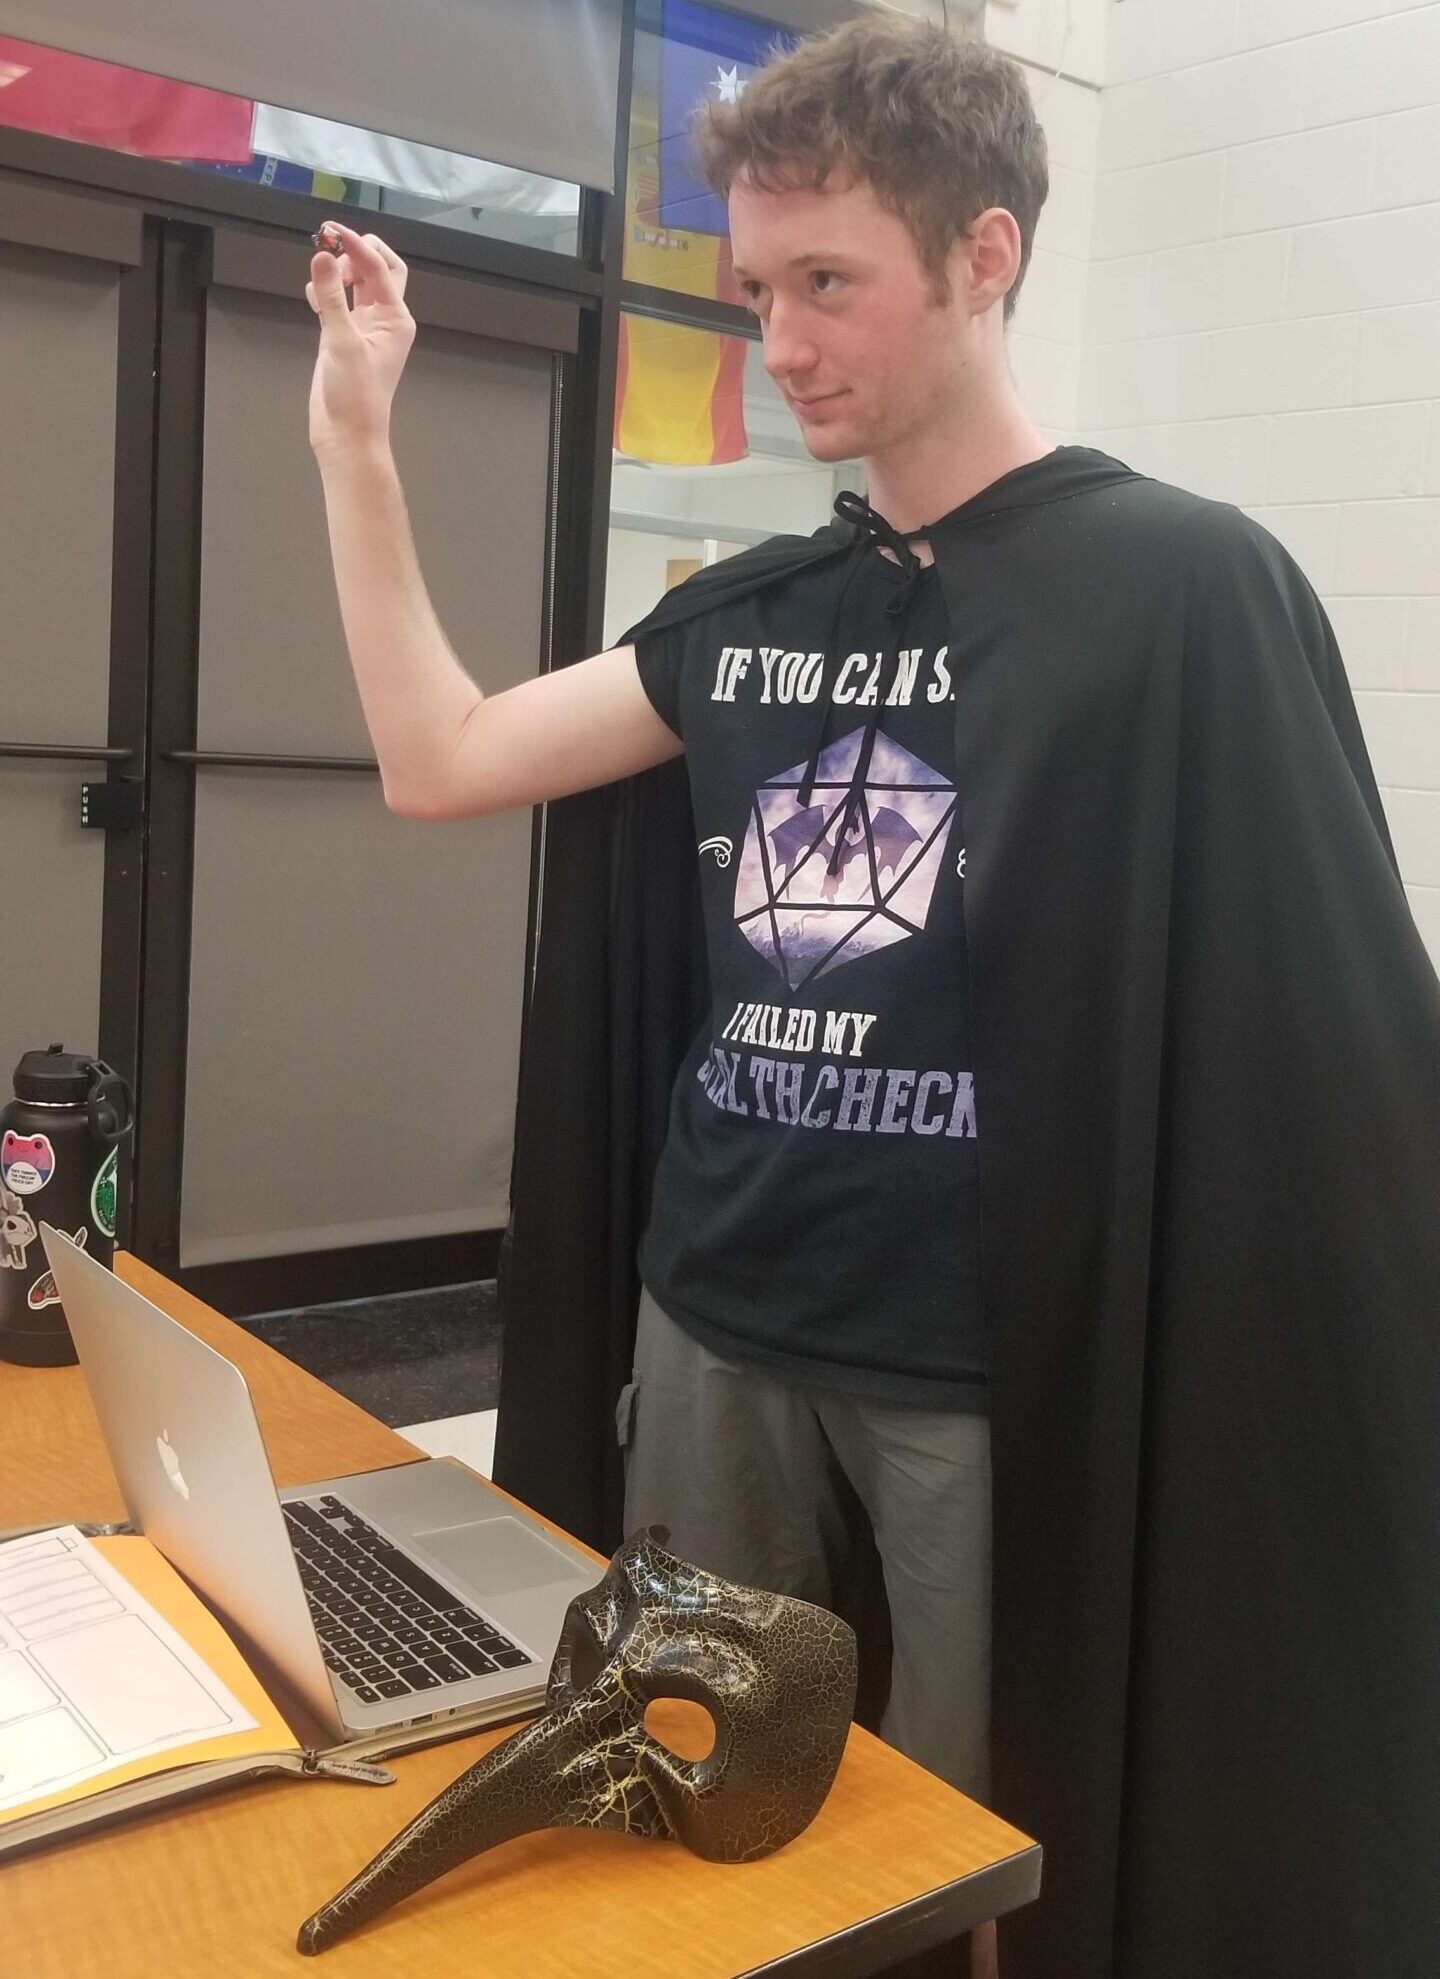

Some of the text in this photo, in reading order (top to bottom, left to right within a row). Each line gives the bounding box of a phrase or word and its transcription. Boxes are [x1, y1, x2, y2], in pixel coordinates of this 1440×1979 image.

[711, 646, 955, 706] IF YOU CAN S
[722, 1002, 877, 1057] I FAILED MY
